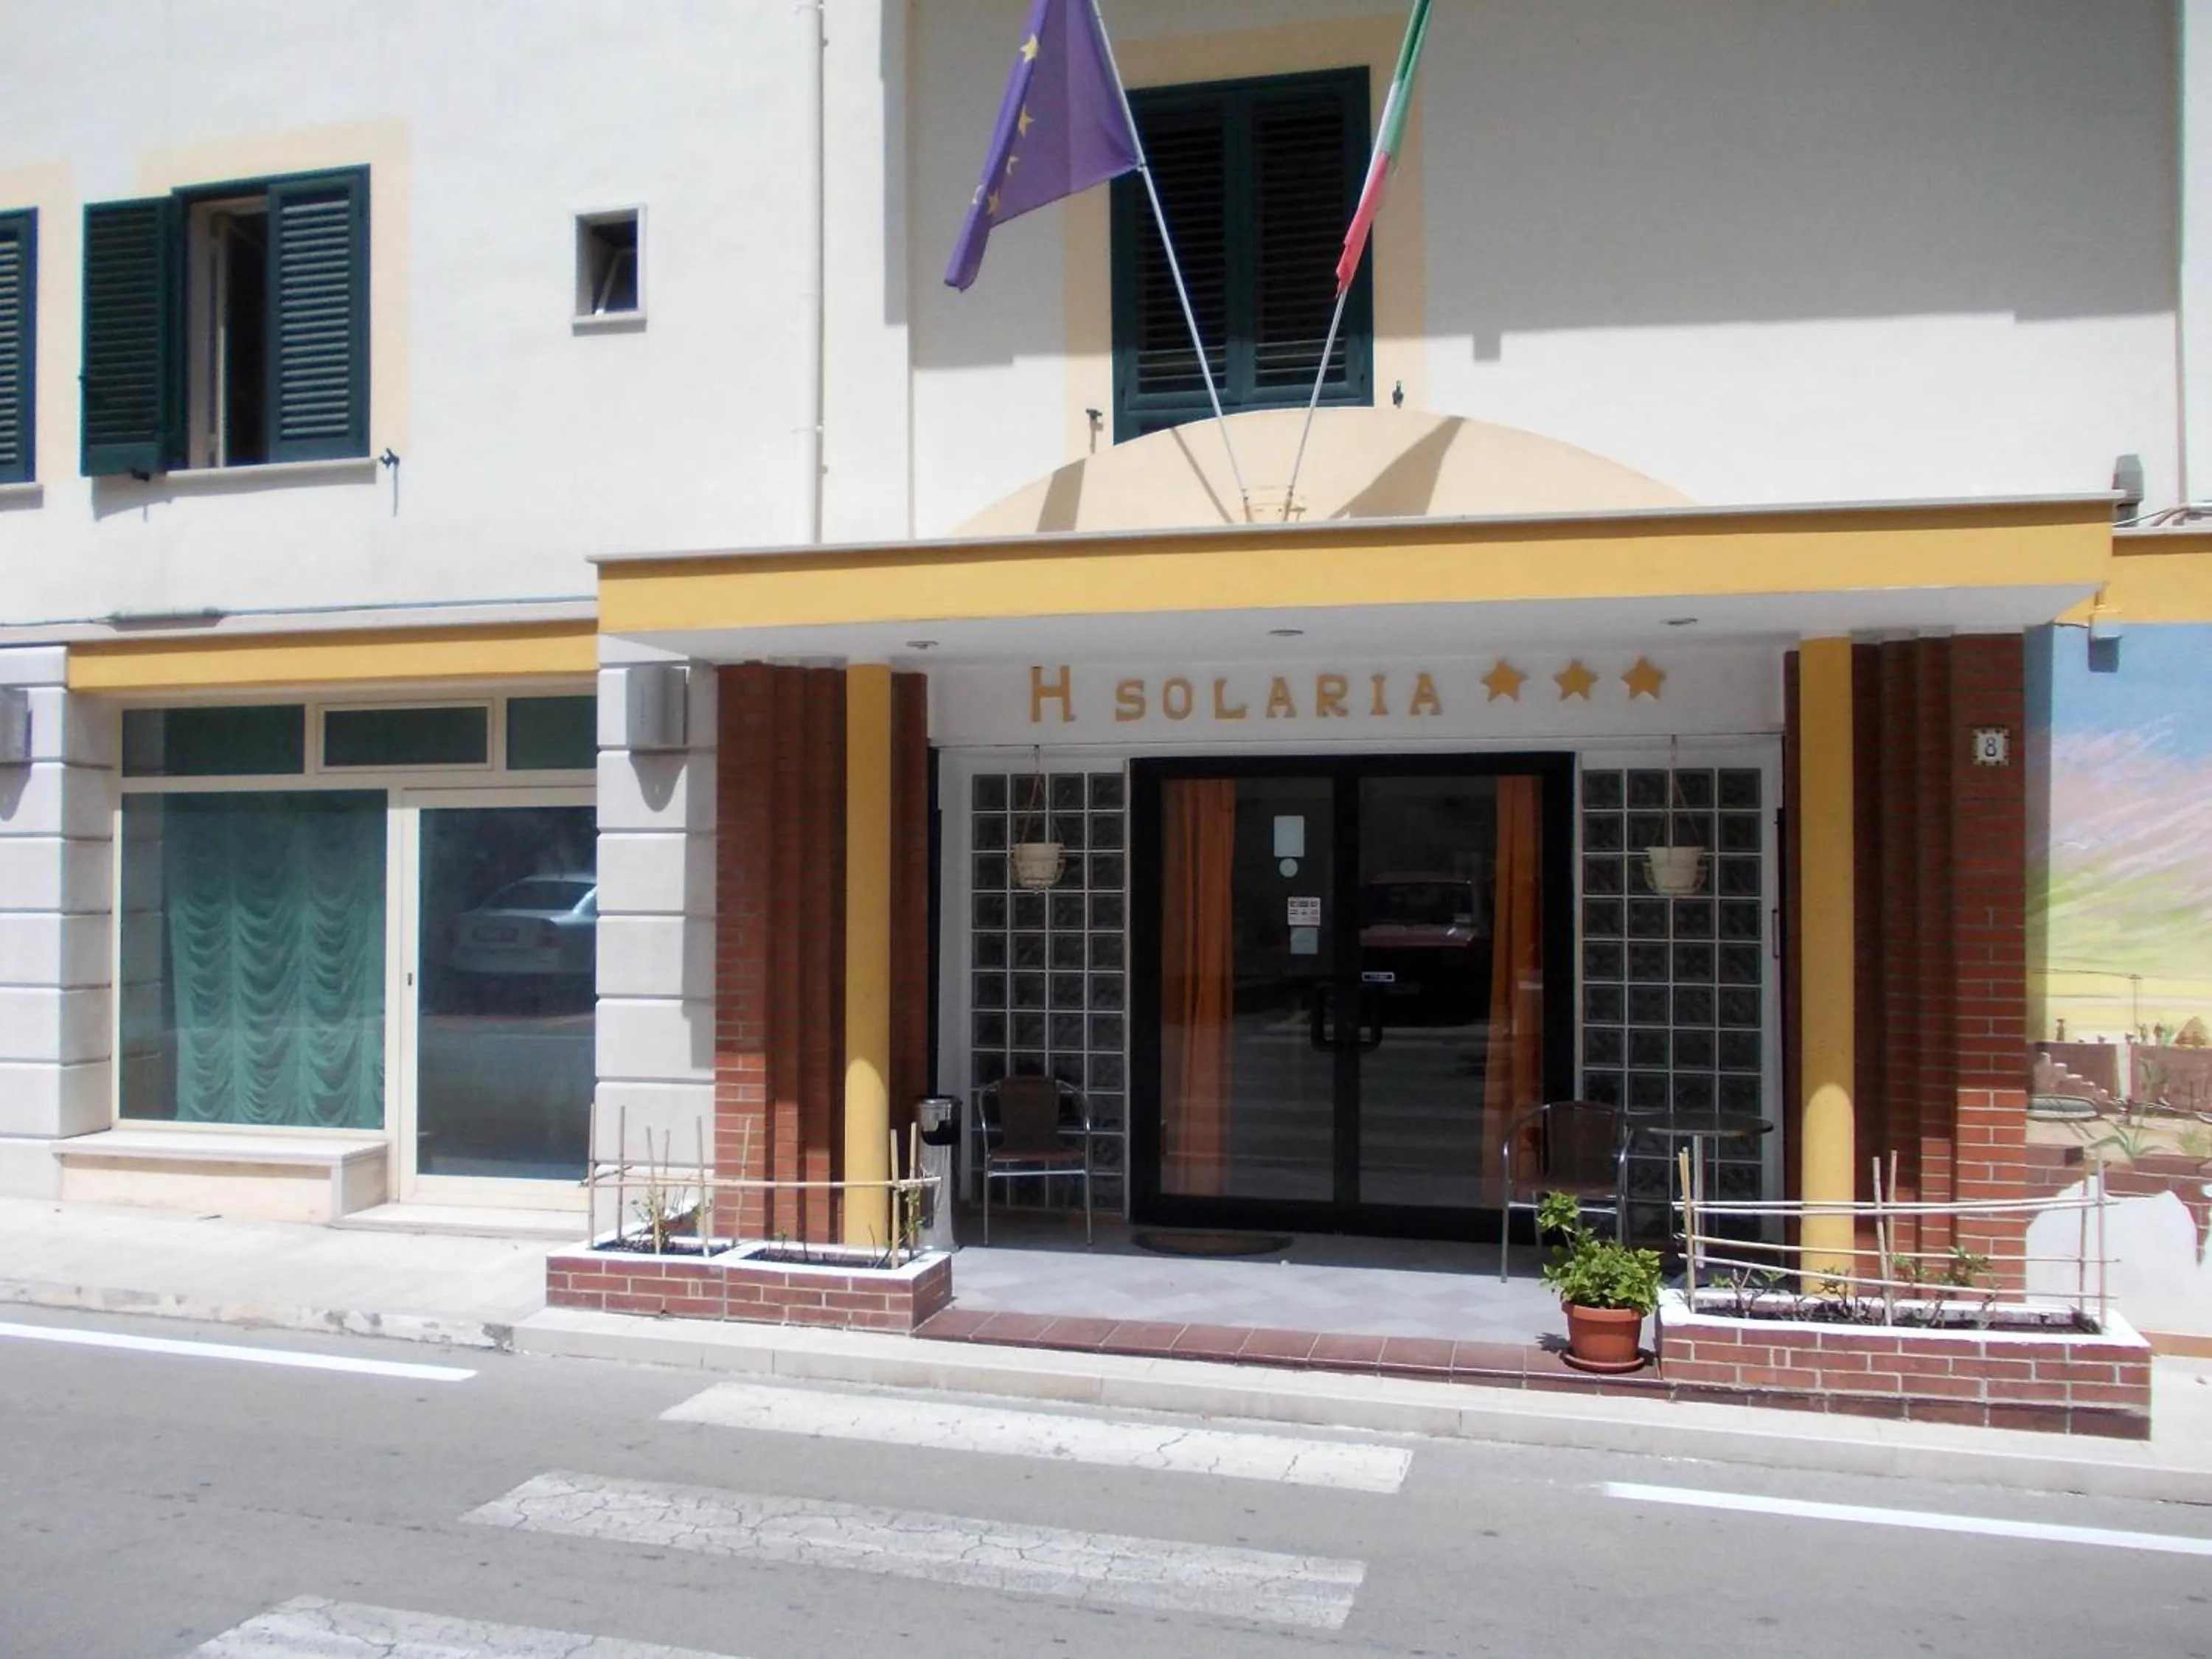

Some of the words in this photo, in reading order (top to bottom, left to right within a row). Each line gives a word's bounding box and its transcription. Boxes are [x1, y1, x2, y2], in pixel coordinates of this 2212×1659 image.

[1030, 665, 1076, 723] H
[1115, 672, 1443, 723] SOLARIA
[1984, 737, 1997, 757] 8
